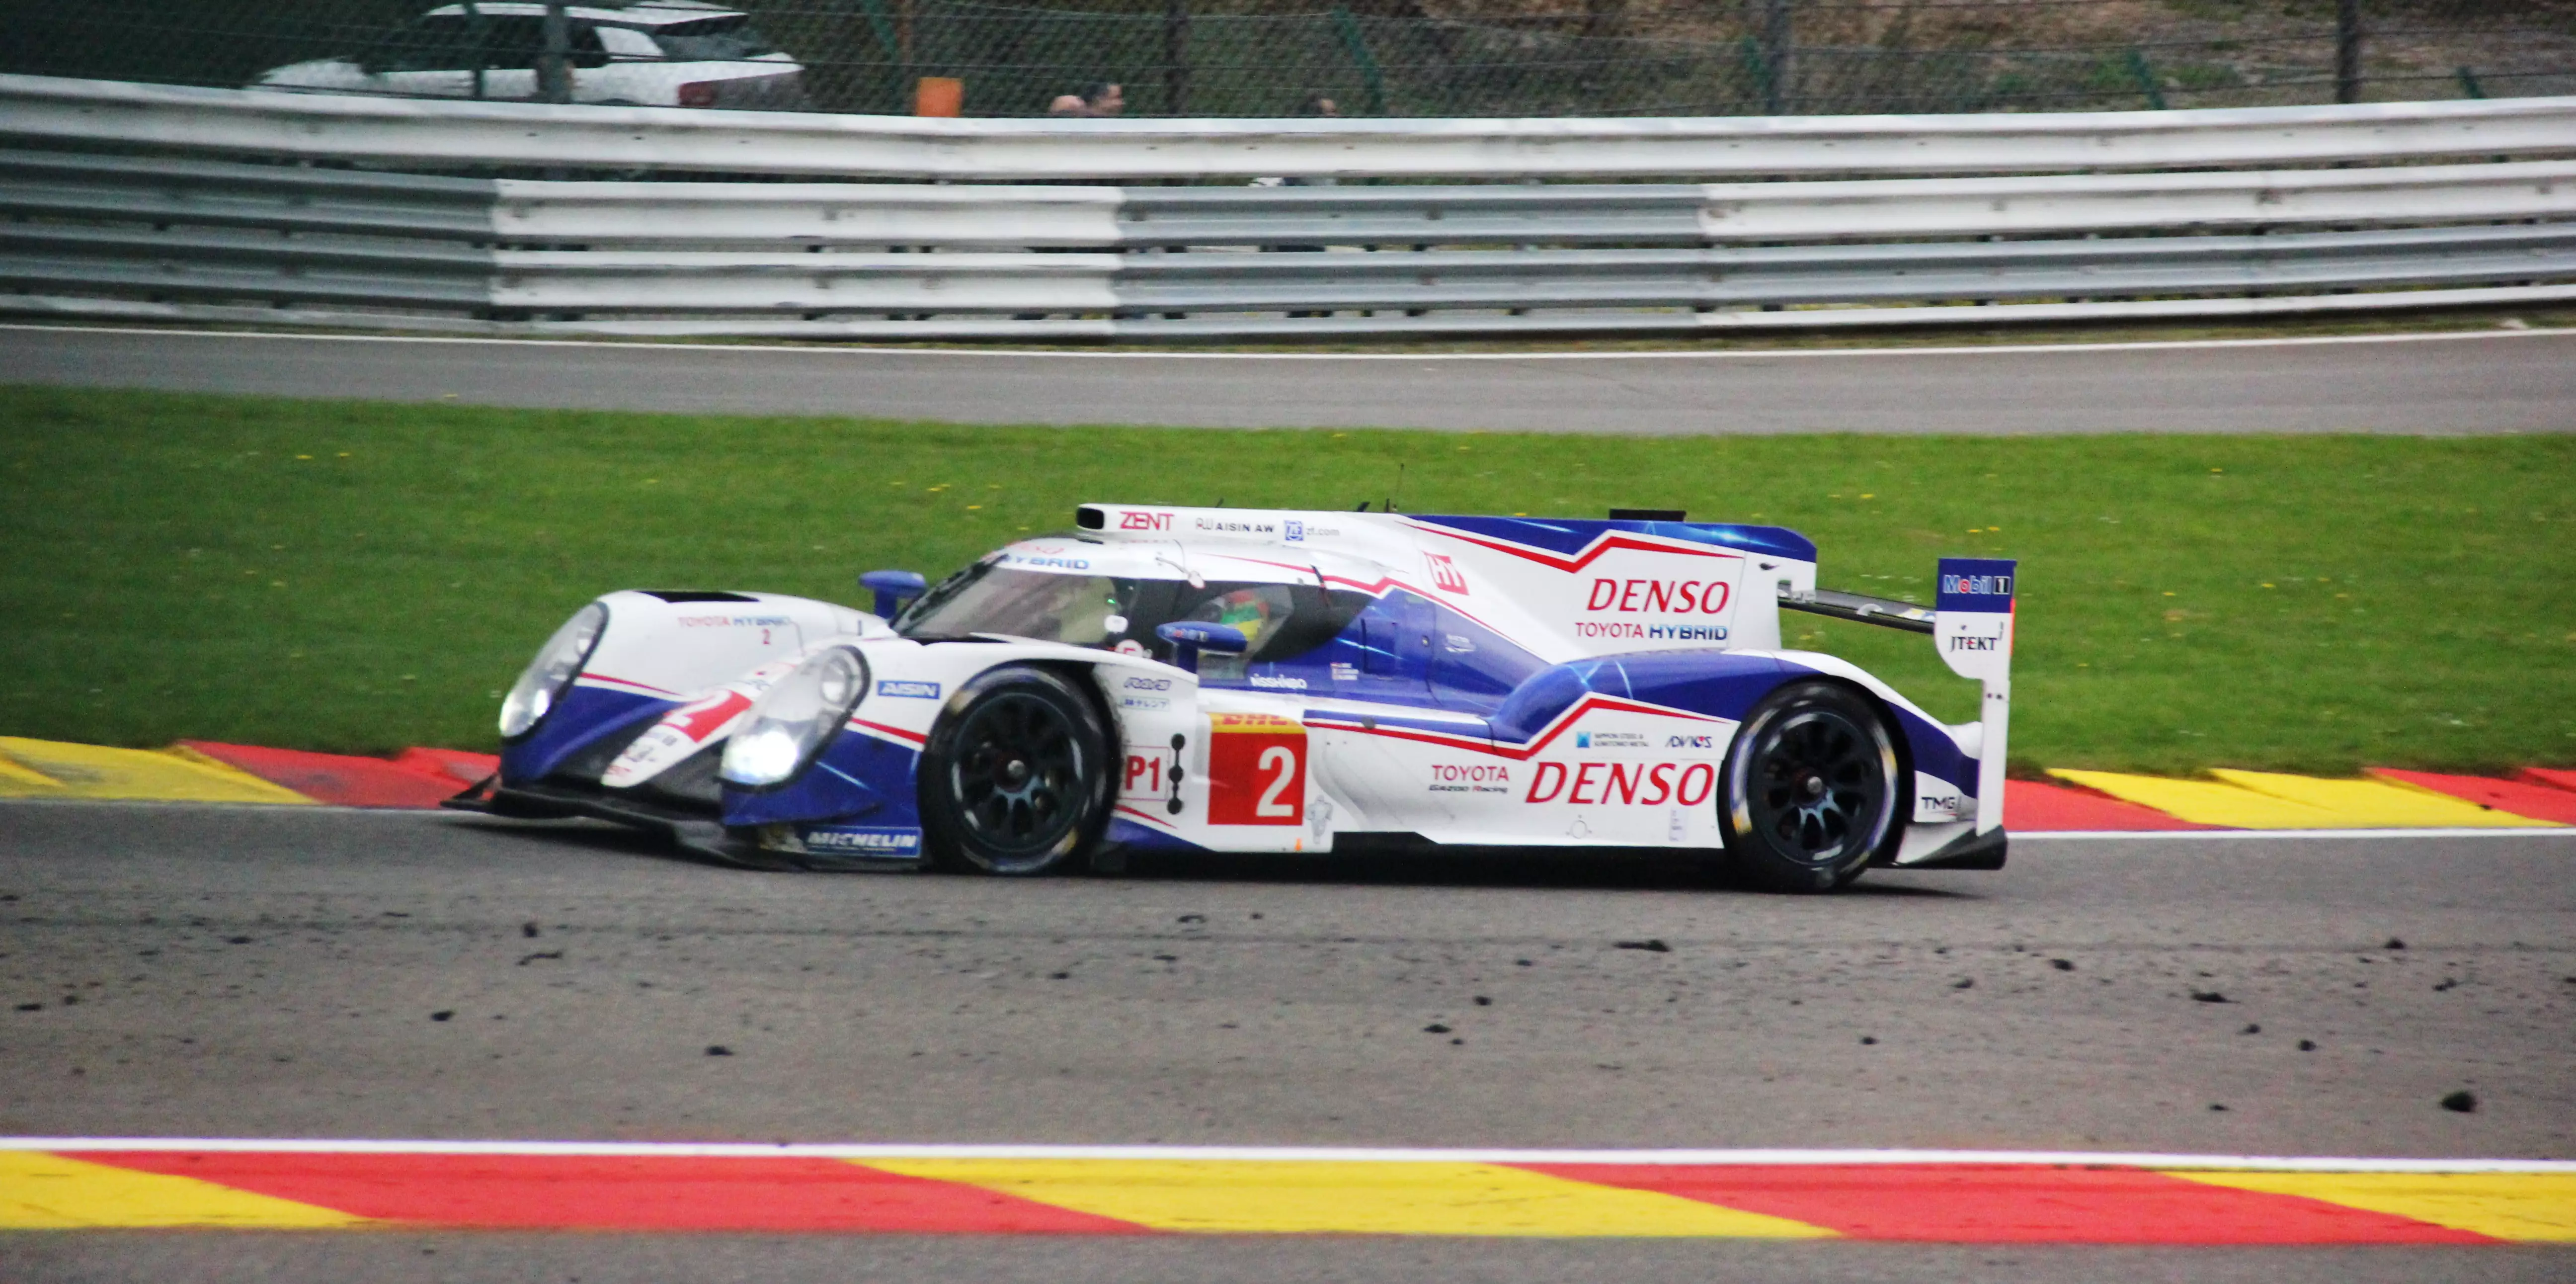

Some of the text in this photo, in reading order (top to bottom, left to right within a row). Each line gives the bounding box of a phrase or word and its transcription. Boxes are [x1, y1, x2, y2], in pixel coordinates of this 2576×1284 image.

[1120, 511, 1175, 530] ZENT
[1215, 523, 1250, 532] AISIN
[1306, 527, 1340, 536] zf.com
[1425, 554, 1462, 588] HY
[1943, 574, 1992, 595] Mobil
[1587, 578, 1730, 614] DENSO
[678, 616, 730, 626] TOYOTA
[762, 628, 771, 645] 2
[1575, 622, 1728, 640] TOYOTA HYBRID
[1950, 636, 1997, 652] JTEKT
[881, 682, 937, 696] AISIN
[1222, 713, 1288, 726] DHL
[1126, 755, 1160, 792] P1
[1256, 745, 1296, 817] 2
[1432, 765, 1509, 781] TOYOTA
[1526, 761, 1714, 806] DENSO
[1921, 796, 1955, 810] TMG
[808, 832, 917, 847] MICHELIN
